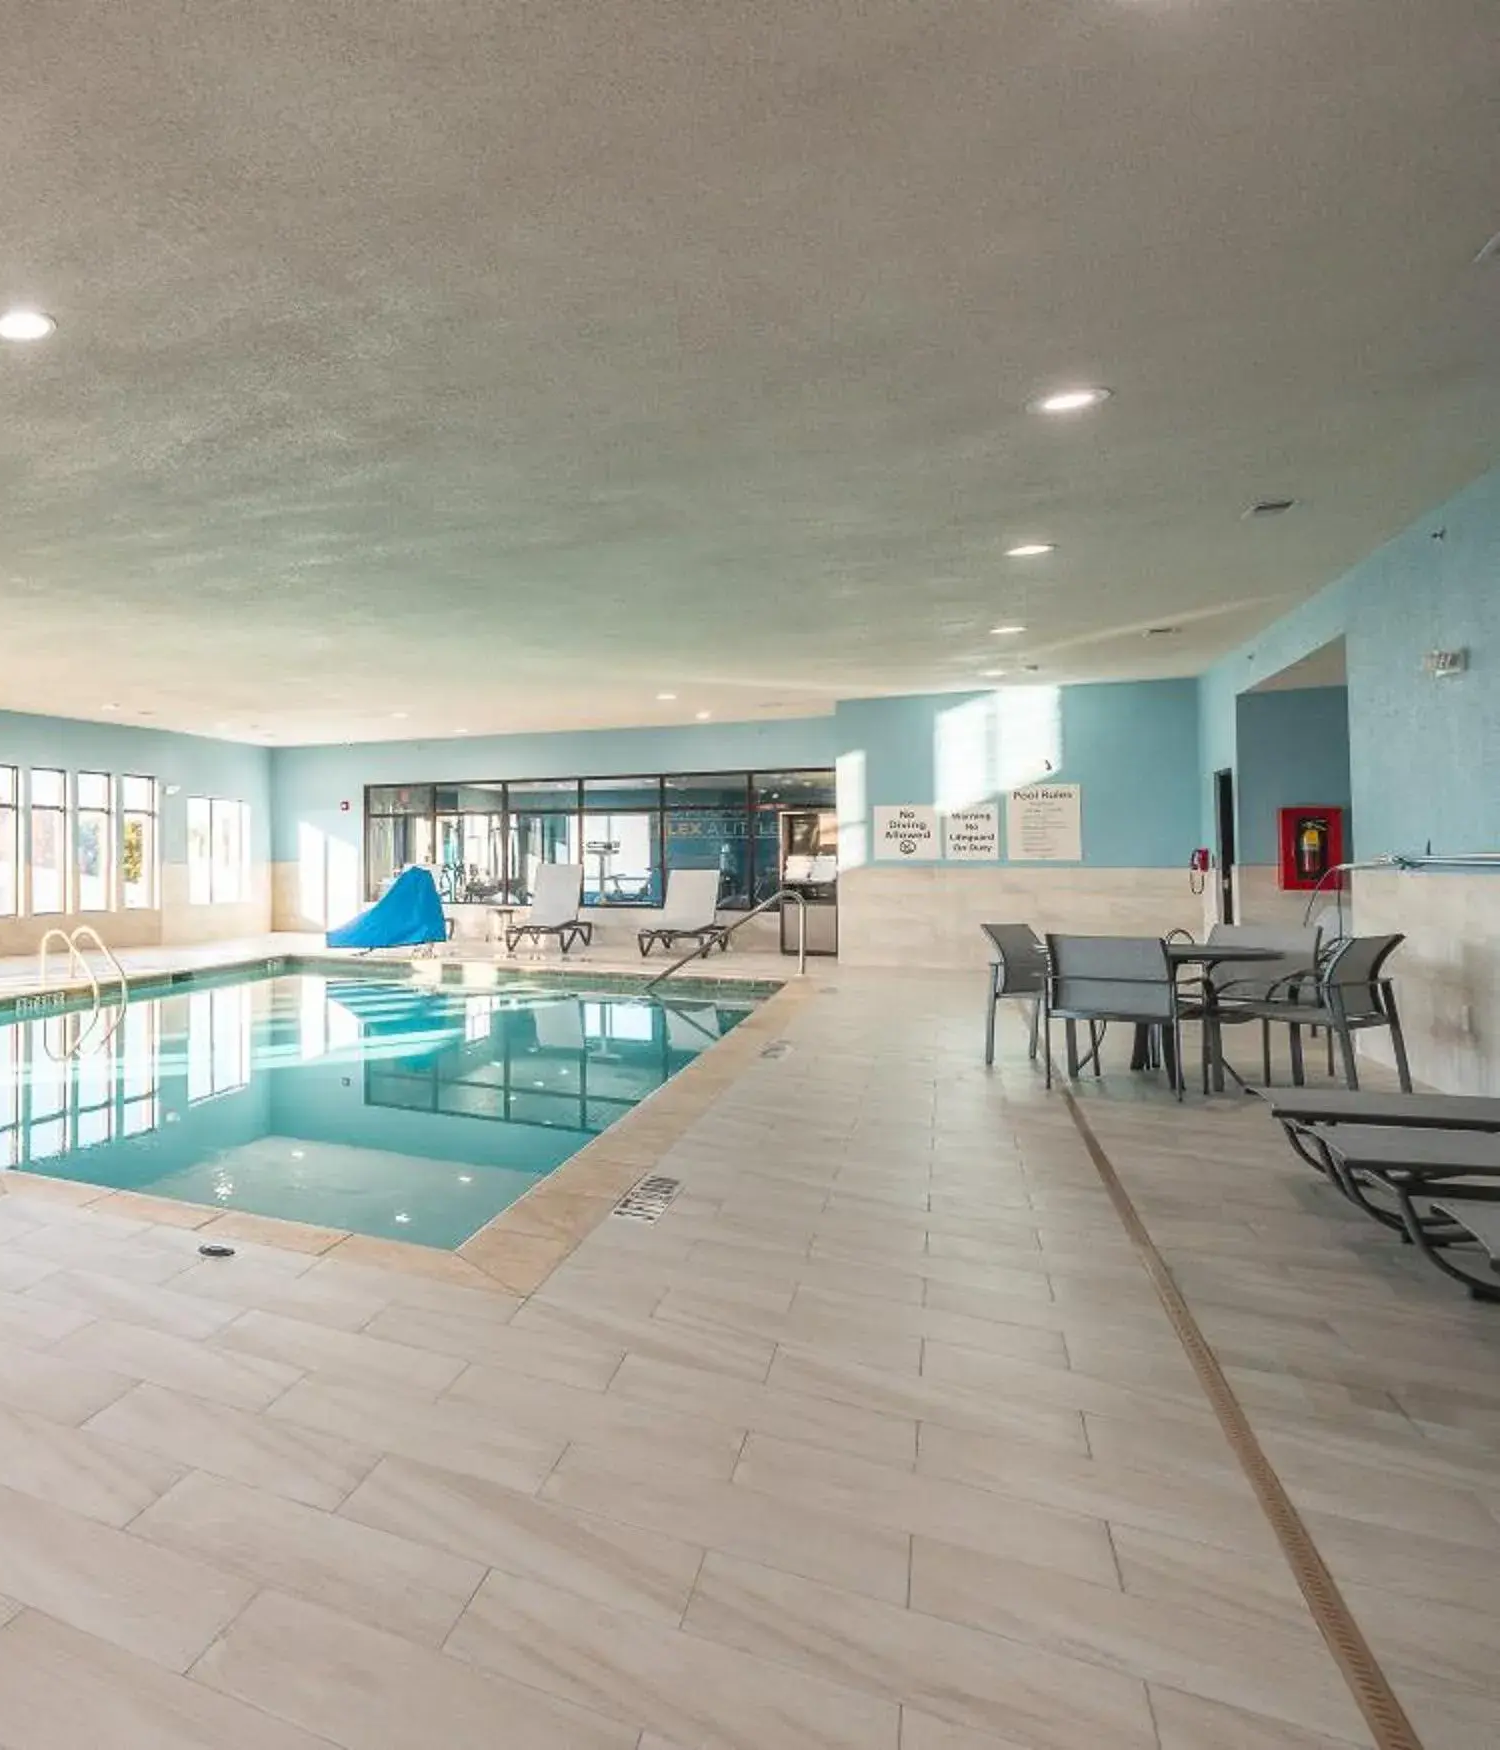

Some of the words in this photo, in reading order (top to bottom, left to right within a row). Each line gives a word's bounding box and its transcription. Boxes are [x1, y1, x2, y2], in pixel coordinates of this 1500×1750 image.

[1013, 790, 1038, 800] Pool
[1041, 790, 1073, 799] Rules
[899, 810, 915, 819] No
[723, 821, 778, 835] LITLE
[889, 820, 927, 830] Diving
[965, 823, 979, 831] No
[885, 831, 931, 839] Allowed
[949, 833, 995, 842] Lifeguard
[953, 843, 967, 851] On
[969, 843, 993, 852] Duty
